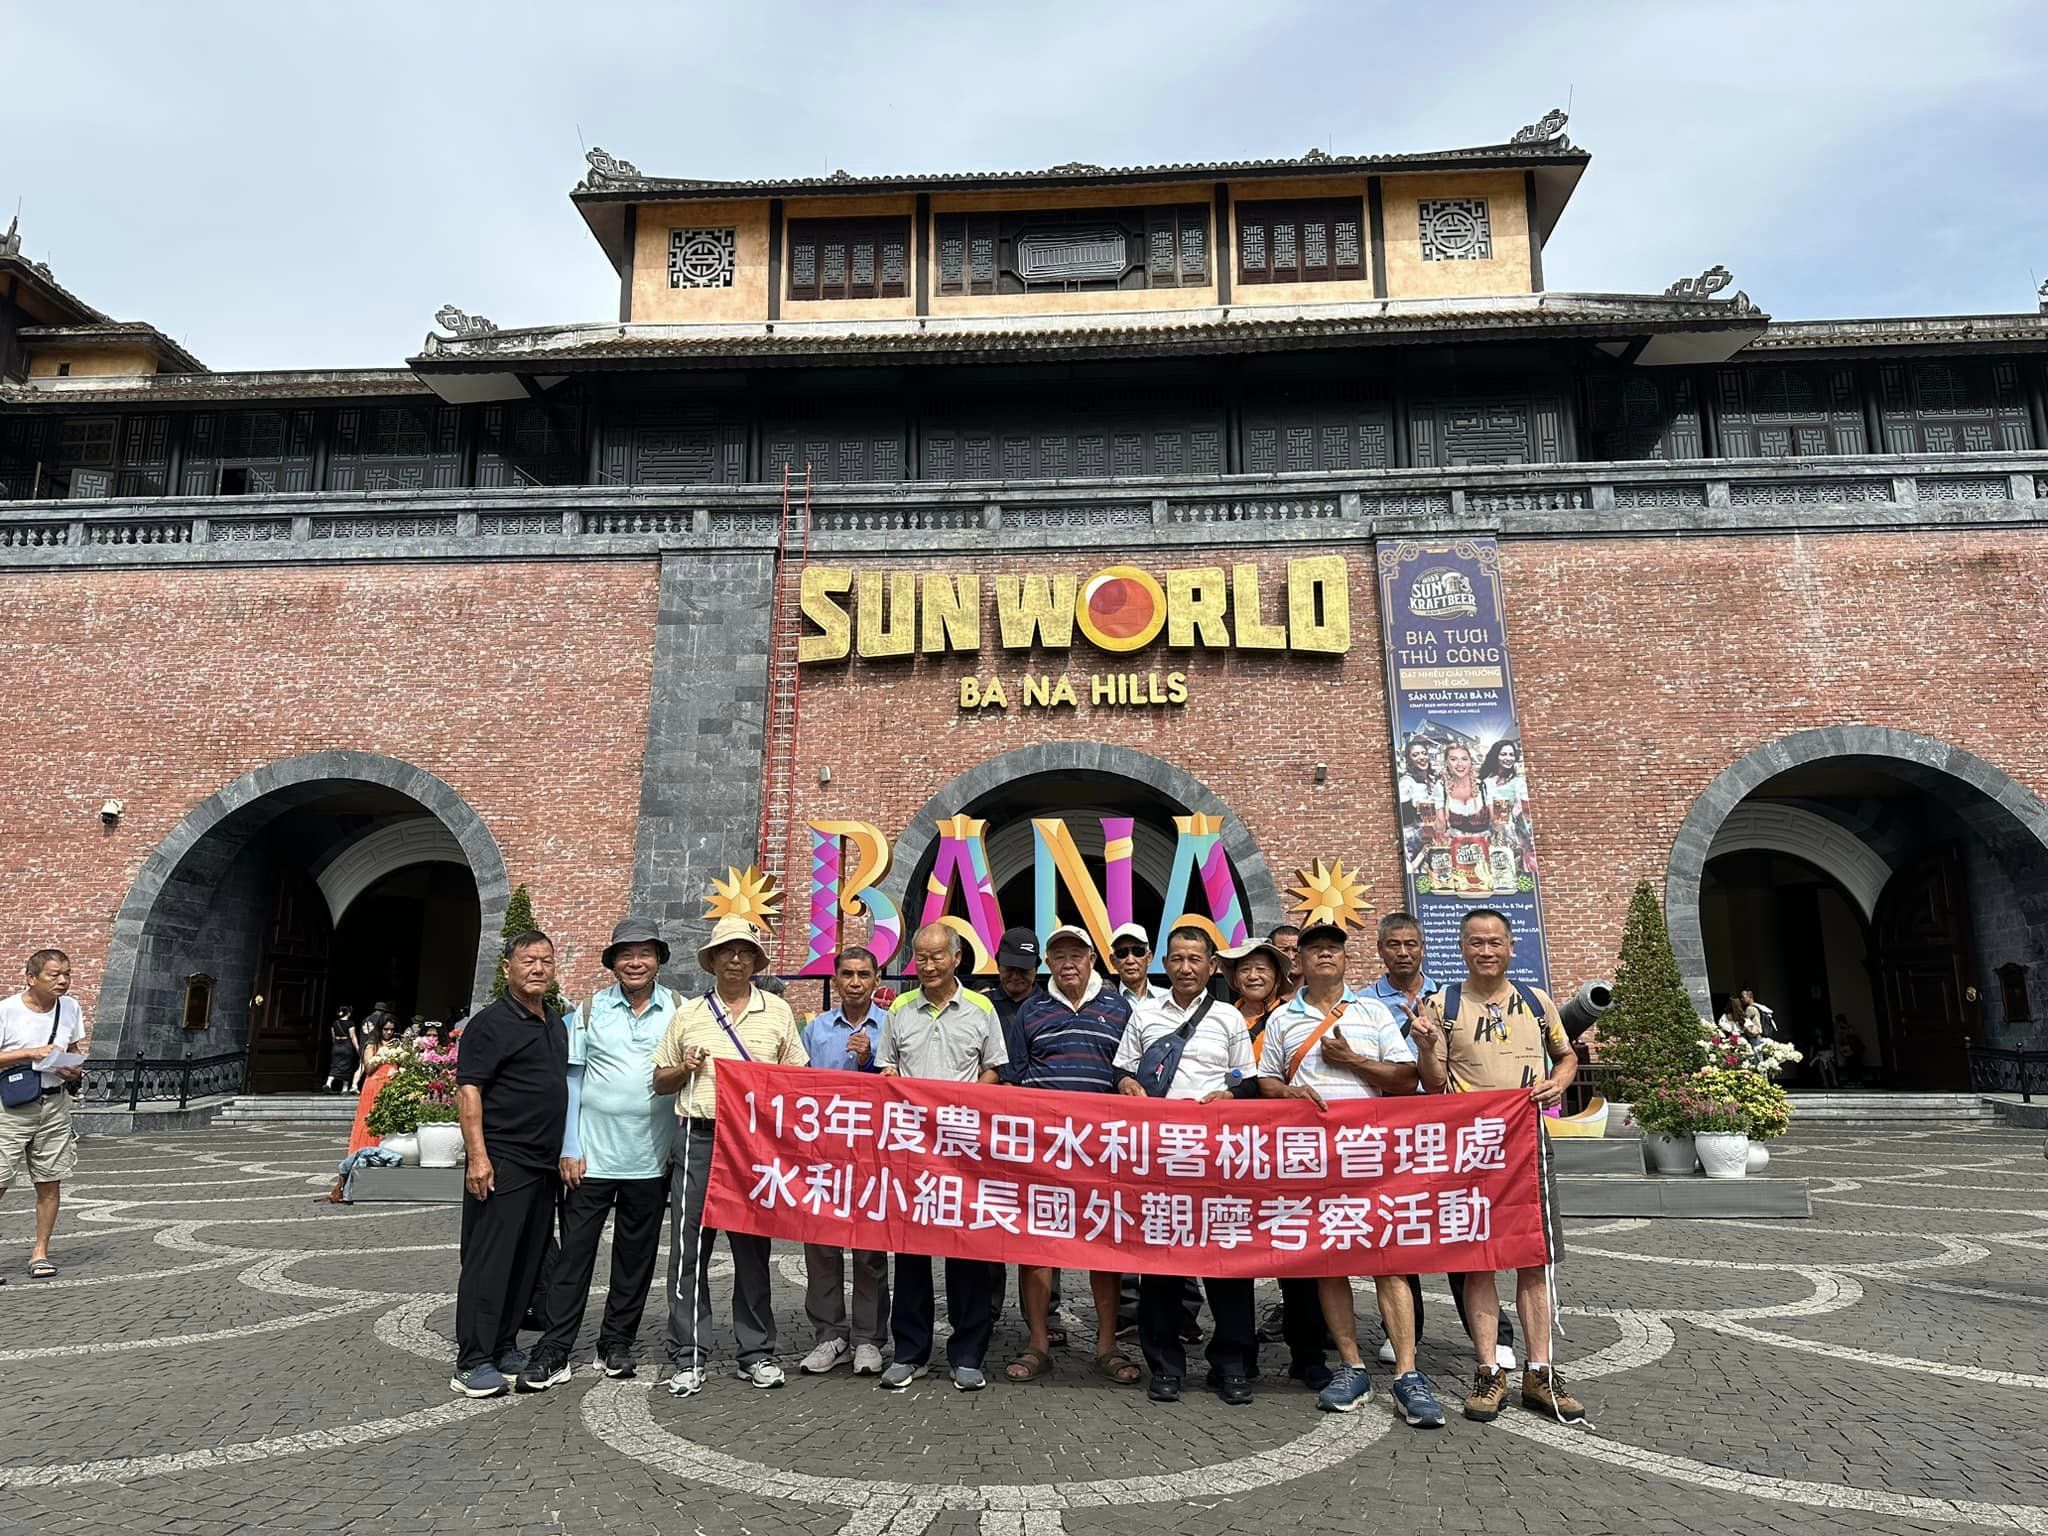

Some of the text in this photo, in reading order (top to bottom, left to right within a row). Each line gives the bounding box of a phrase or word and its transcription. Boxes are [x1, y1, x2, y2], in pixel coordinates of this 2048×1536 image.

[1408, 593, 1477, 610] KRAFTBEER
[1411, 581, 1443, 598] SUN
[799, 555, 1352, 664] SUN WORLD
[1406, 628, 1488, 646] BIA TƯƠI
[1398, 645, 1500, 665] THỦ CÔNG
[960, 671, 1189, 708] BA NA HILLS
[745, 1091, 1508, 1180] 113年度農田水利署桃園管理處
[749, 1156, 1492, 1251] 水利小組長國外觀摩考察活動
